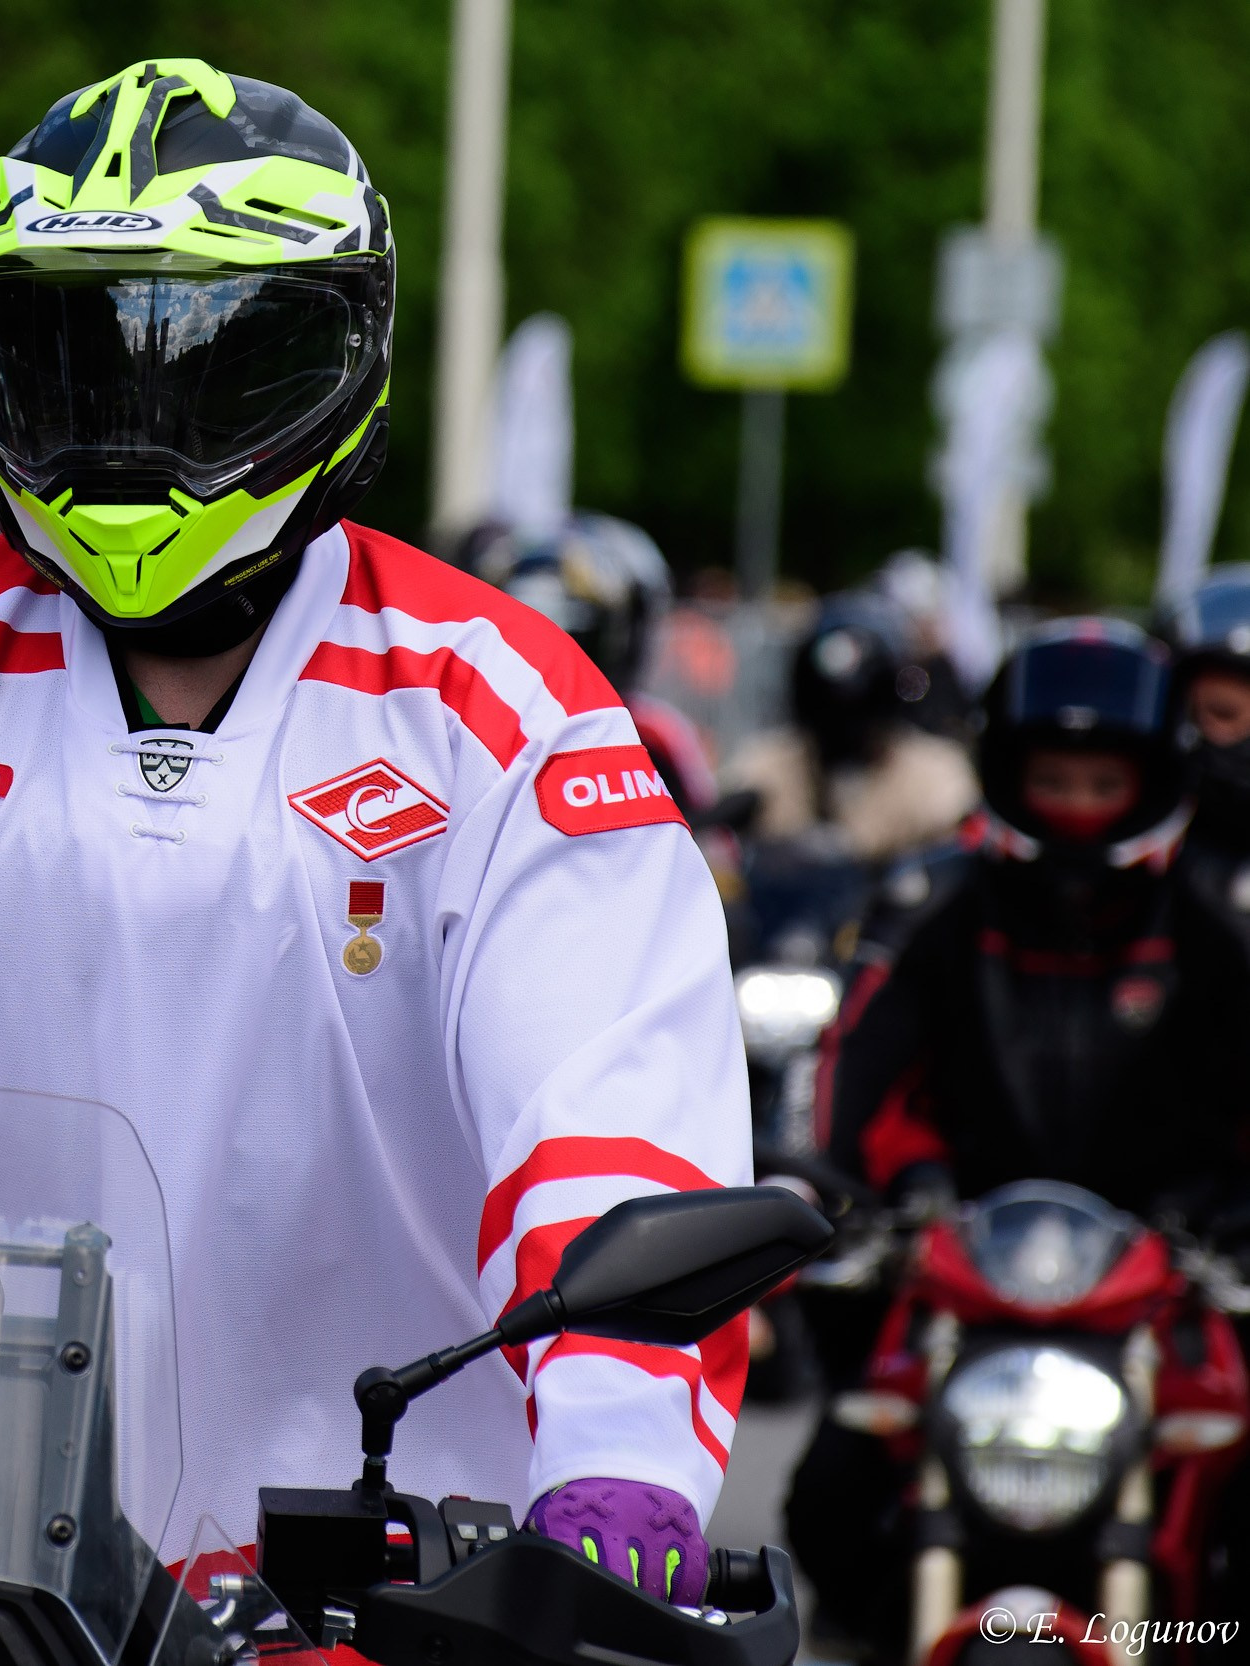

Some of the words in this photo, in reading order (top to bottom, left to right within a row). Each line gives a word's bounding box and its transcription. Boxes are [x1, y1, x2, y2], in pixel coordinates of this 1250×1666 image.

[44, 215, 145, 230] HJC
[224, 564, 257, 586] EMERGENCY
[258, 558, 268, 568] USE
[269, 550, 283, 561] ONLY
